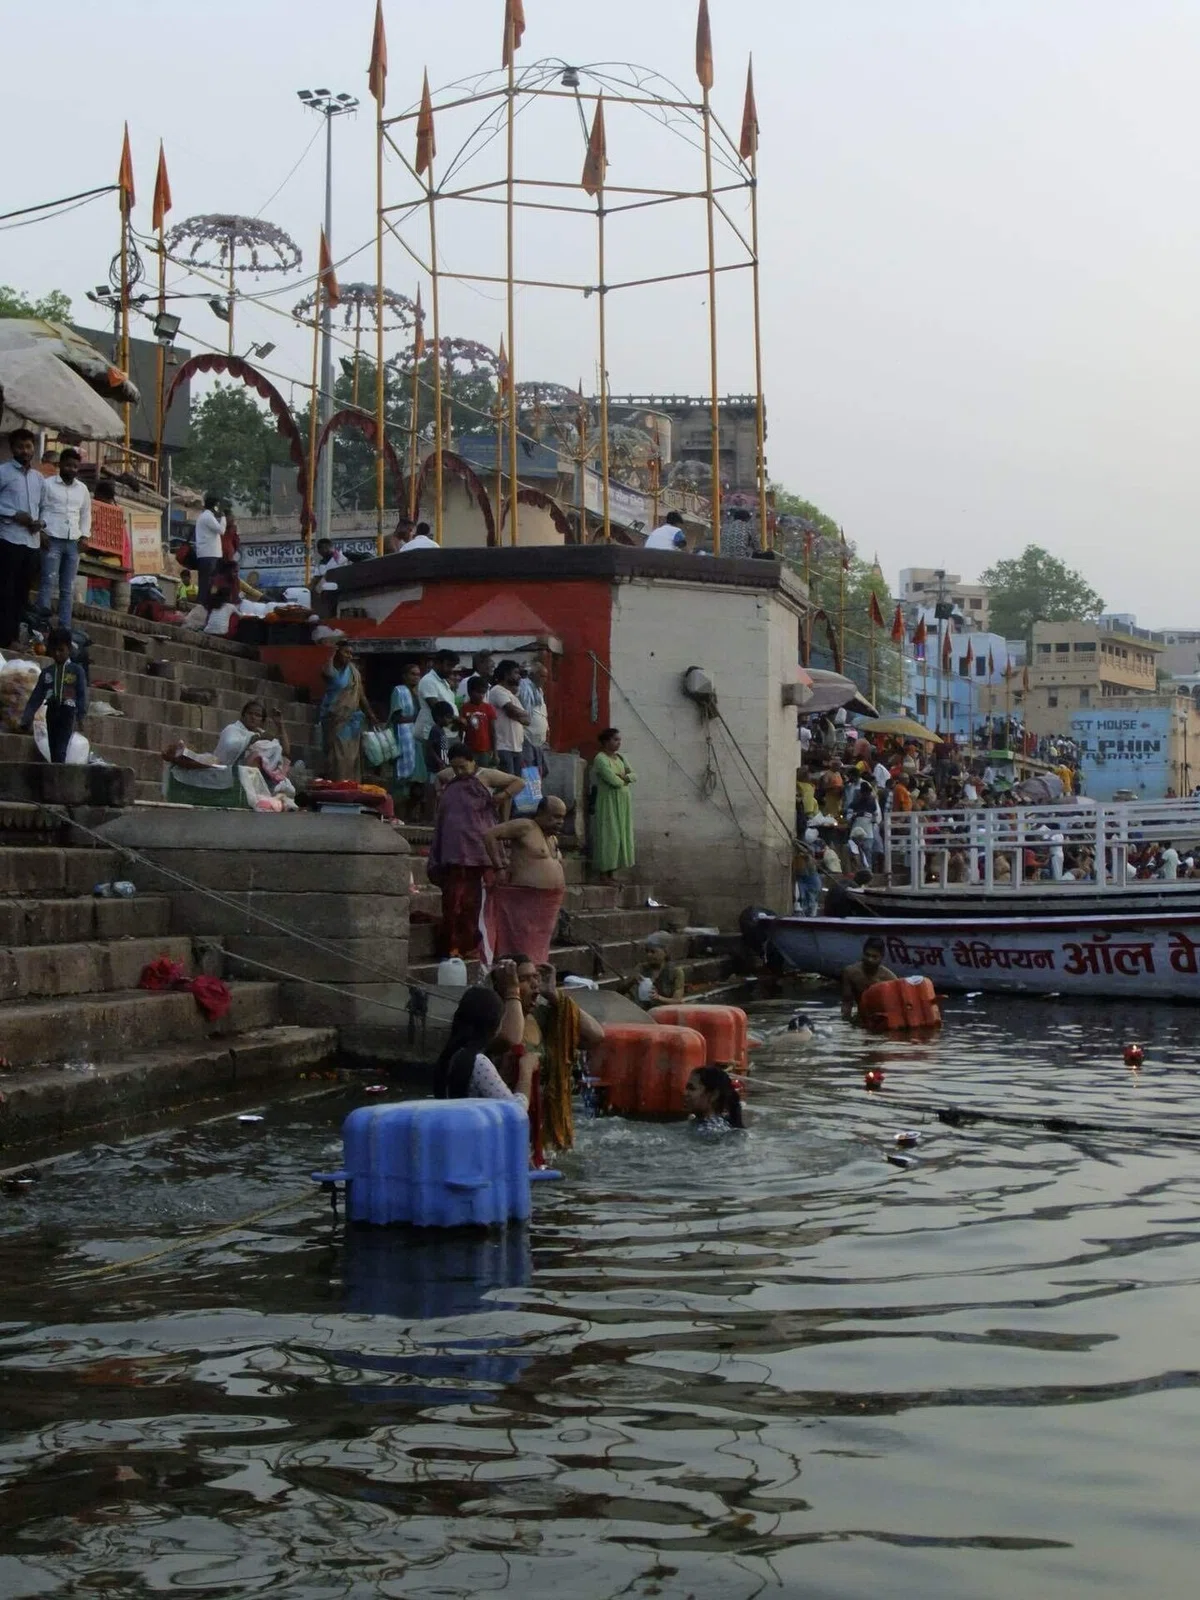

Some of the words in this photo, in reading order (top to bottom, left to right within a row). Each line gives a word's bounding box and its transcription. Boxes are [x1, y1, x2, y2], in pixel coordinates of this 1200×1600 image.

[1097, 720, 1137, 730] HOUSE
[951, 939, 1055, 970] चैम्पियन
[1062, 933, 1155, 976] ऑल
